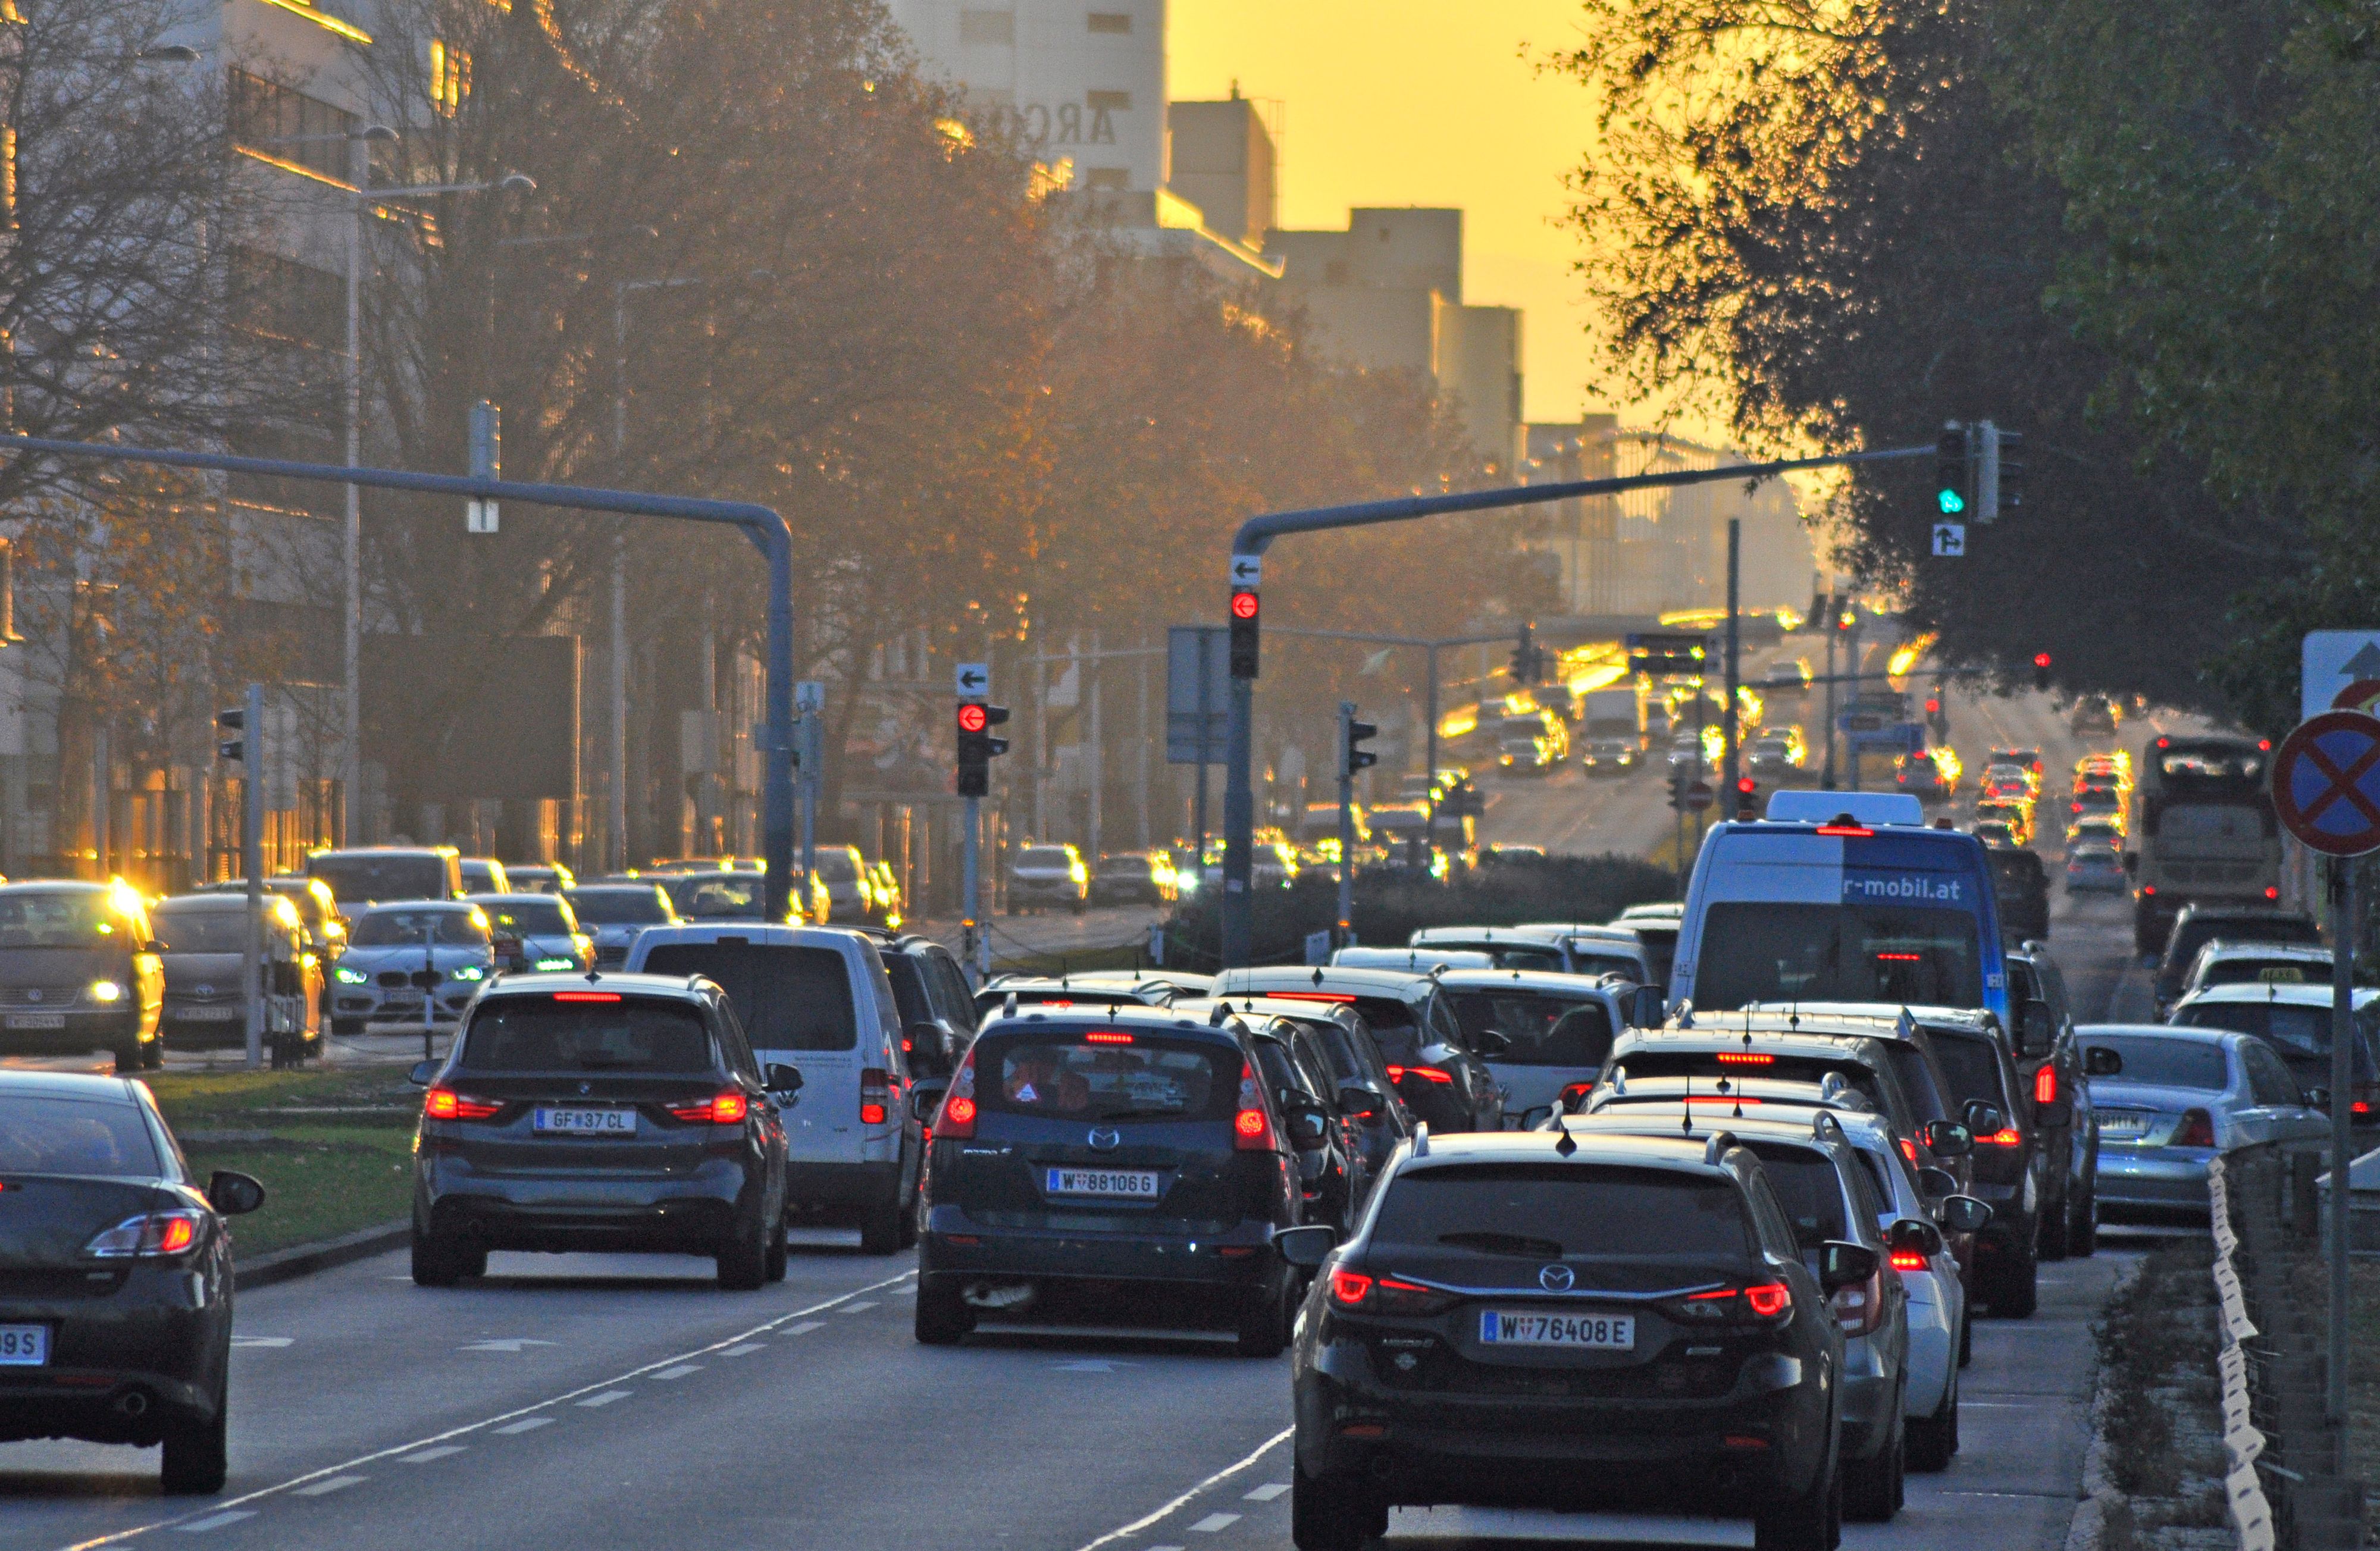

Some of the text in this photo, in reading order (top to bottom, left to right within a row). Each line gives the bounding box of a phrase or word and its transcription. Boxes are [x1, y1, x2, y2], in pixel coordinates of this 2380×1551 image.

[1844, 878, 1960, 900] r-mobil.at
[554, 1113, 625, 1129] GF 37 CL
[1063, 1173, 1075, 1189] W
[1089, 1174, 1137, 1192] 88106
[1501, 1315, 1627, 1343] W 76408 E
[0, 1333, 17, 1355] 9
